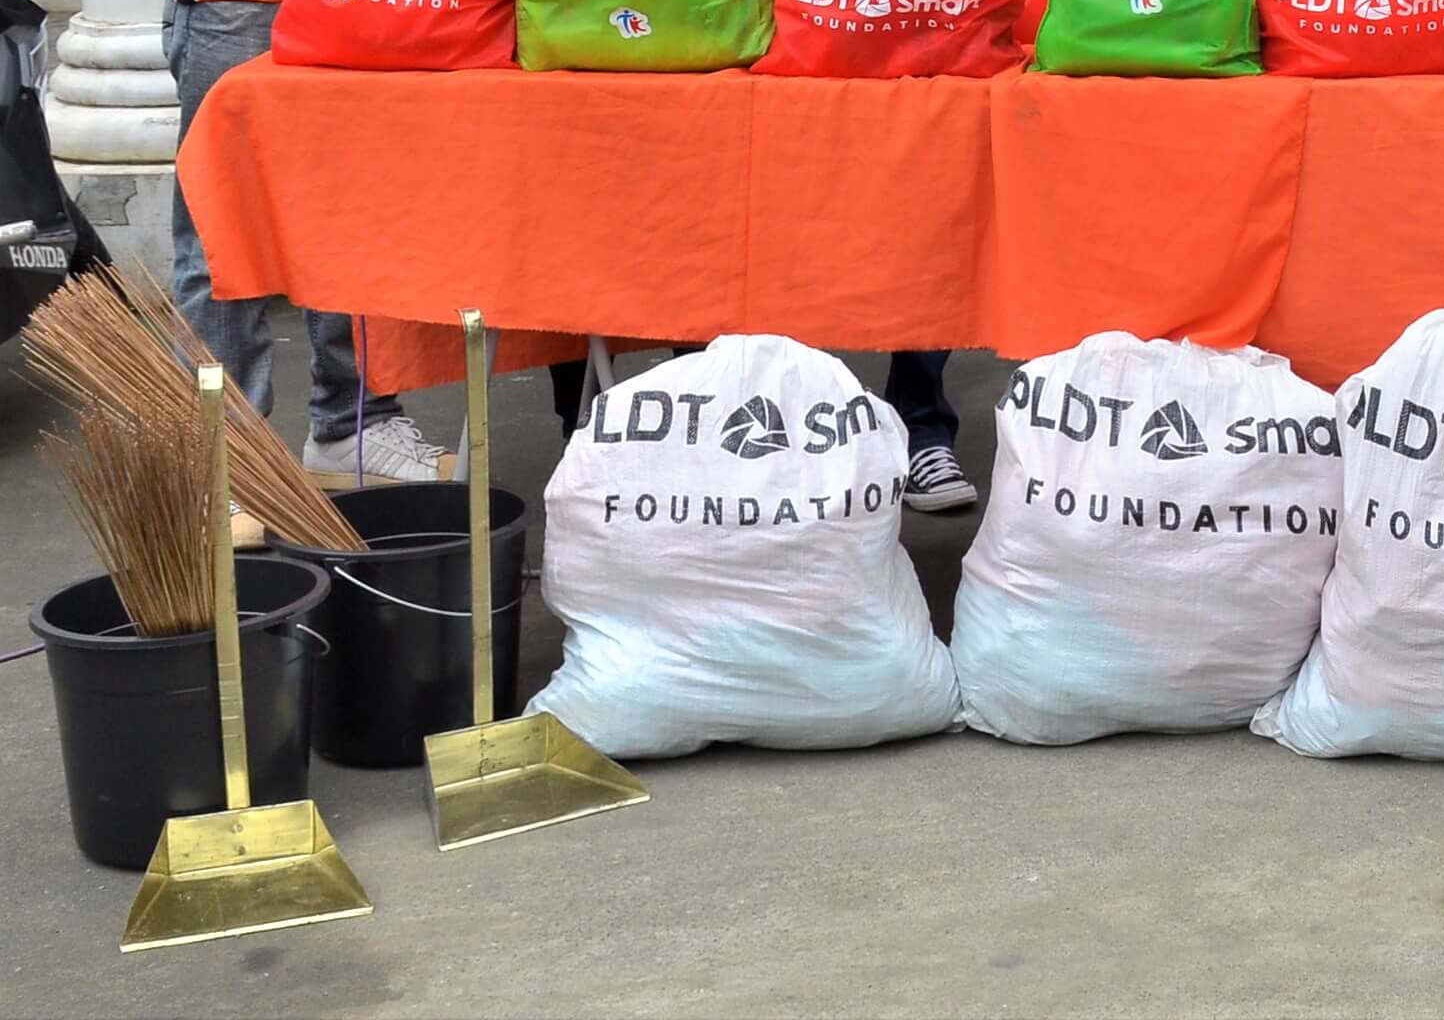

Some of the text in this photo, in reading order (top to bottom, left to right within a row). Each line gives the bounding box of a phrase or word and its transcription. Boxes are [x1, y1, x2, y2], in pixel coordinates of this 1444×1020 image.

[8, 245, 69, 269] HONDA
[995, 368, 1135, 448] PLDT
[604, 474, 907, 527] FOUNDATION
[1025, 477, 1337, 537] FOUNDATION
